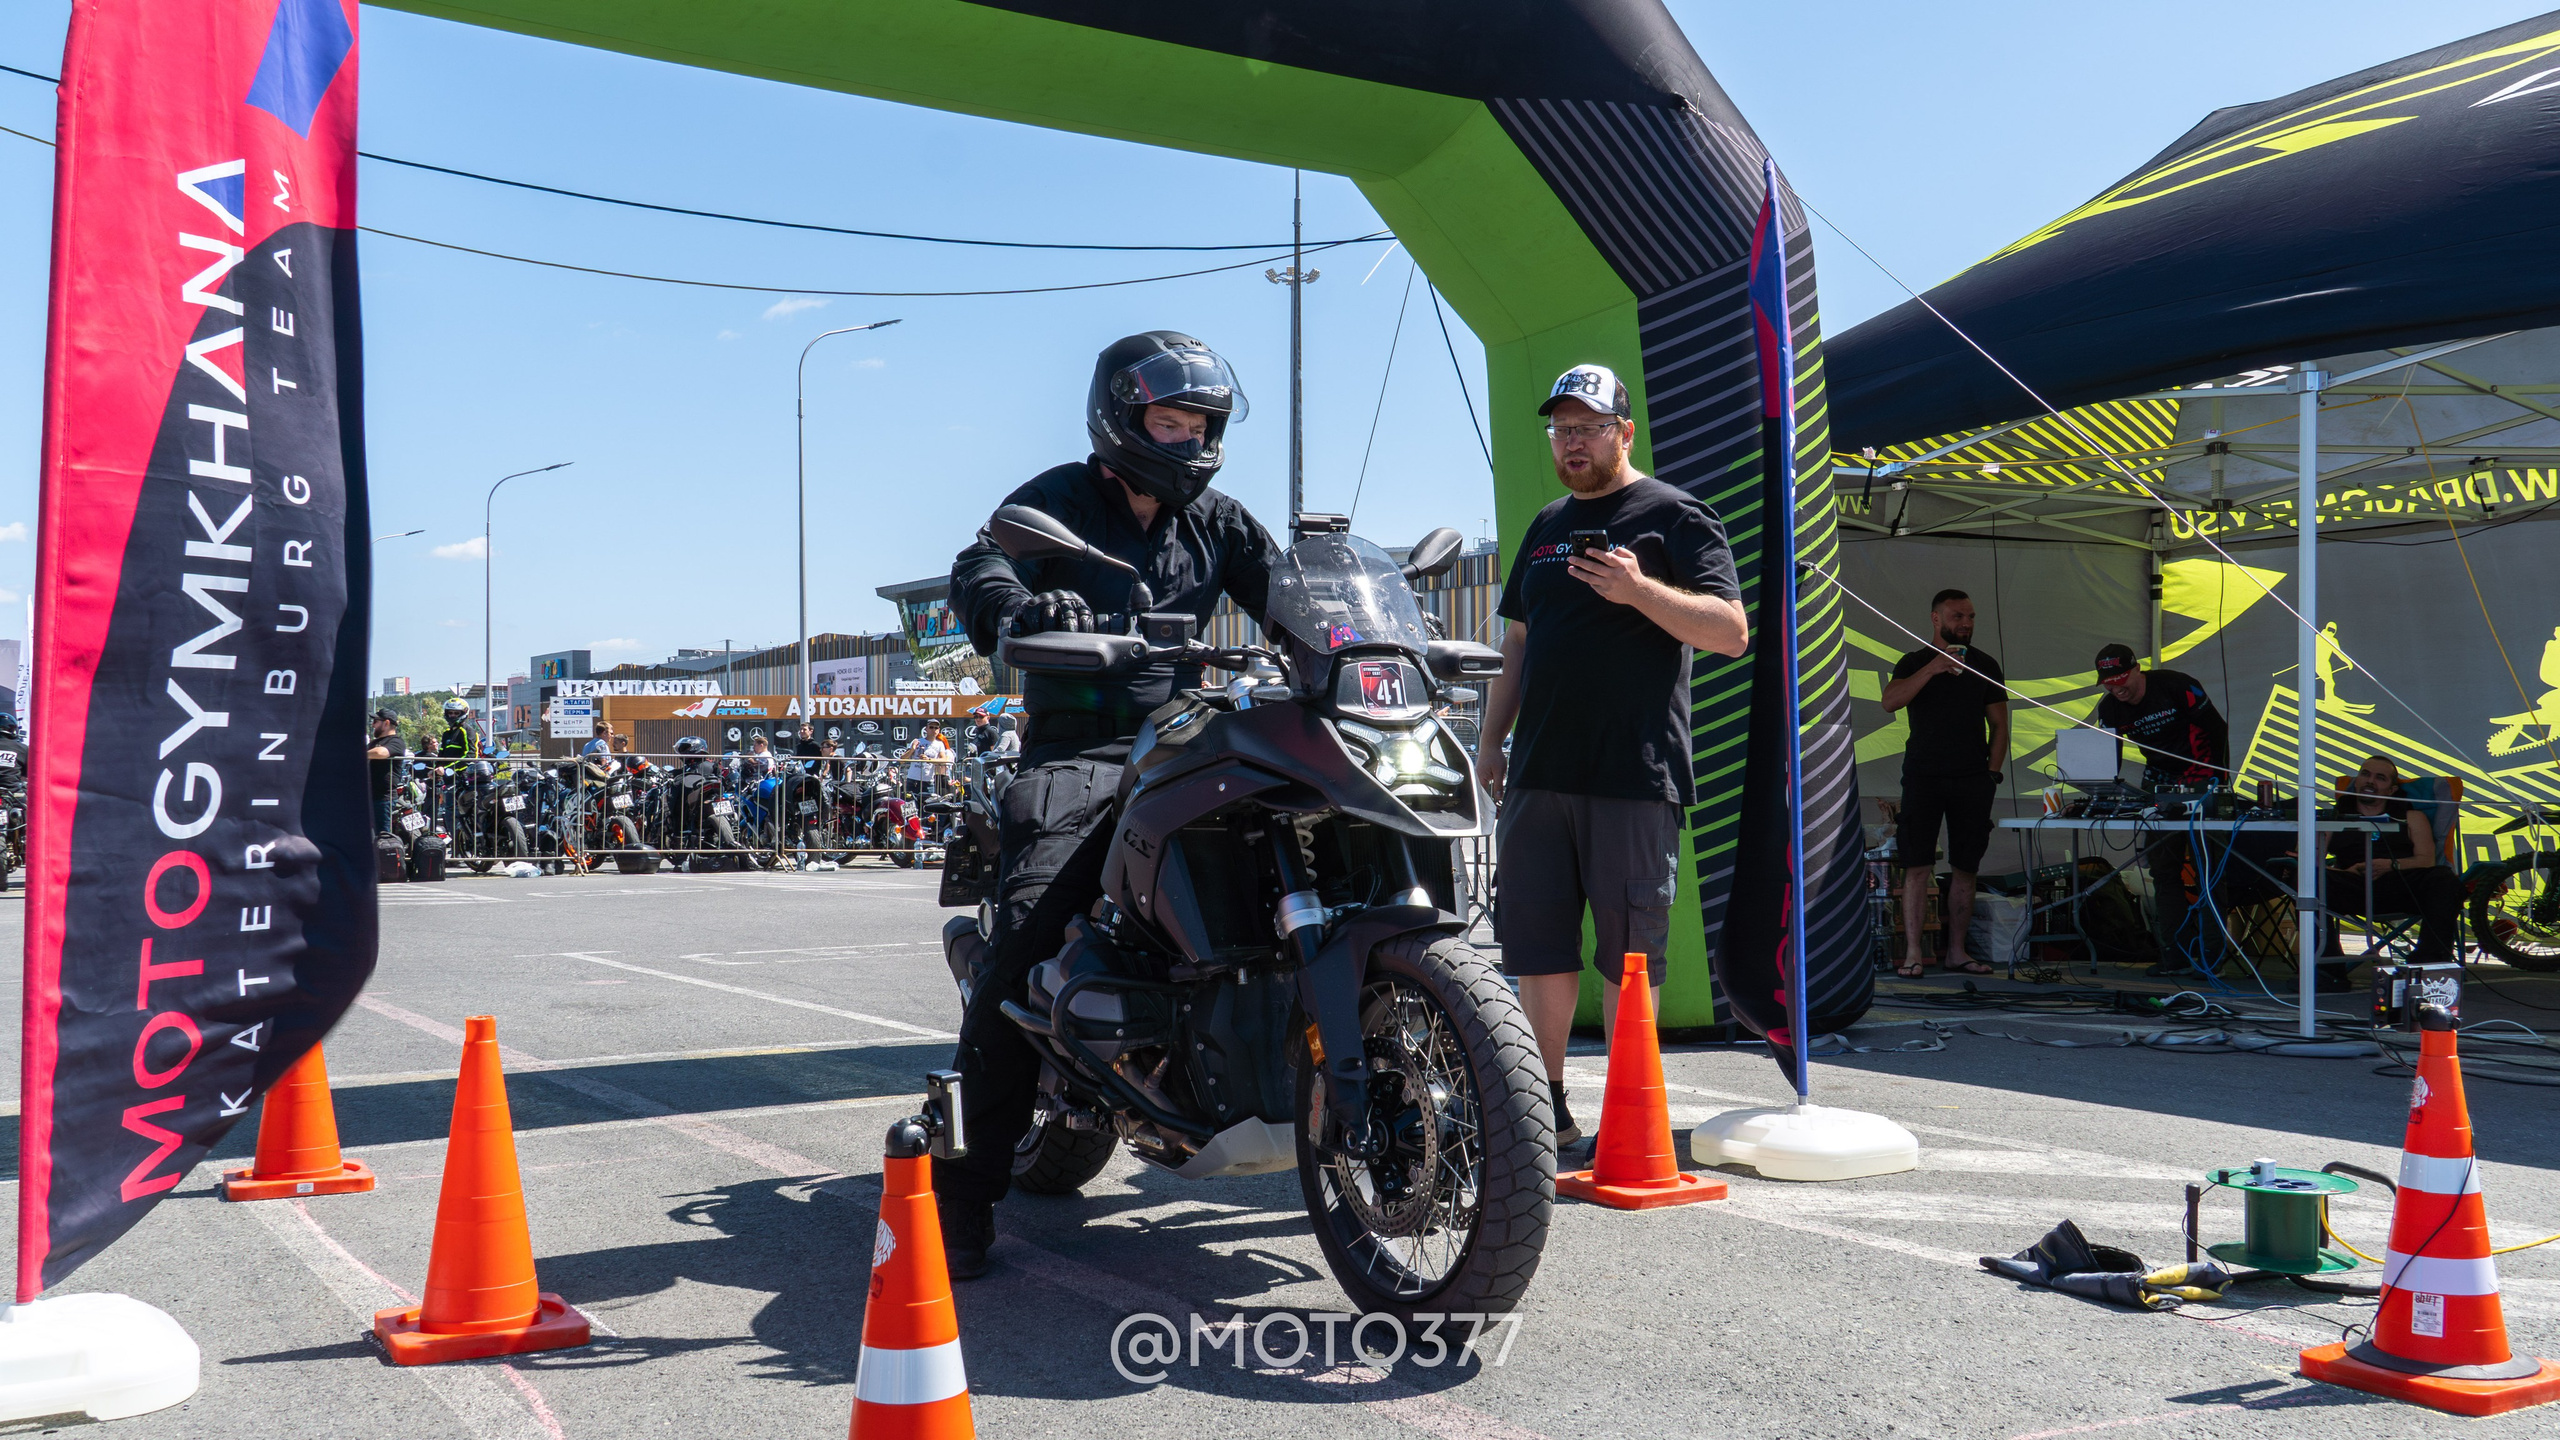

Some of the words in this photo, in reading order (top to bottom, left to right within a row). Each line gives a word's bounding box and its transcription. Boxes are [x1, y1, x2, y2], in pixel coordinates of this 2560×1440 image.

[272, 169, 298, 395] TEAM
[1096, 408, 1123, 447] LS2
[120, 158, 253, 1203] MOTOGYMKHANA
[1376, 678, 1404, 705] 41
[715, 707, 768, 716] ЯПОНЕЦ
[717, 699, 751, 707] АВТО
[786, 697, 953, 716] АВТОЗАПЧАСТИ
[1123, 828, 1157, 859] GS
[1312, 1091, 1321, 1128] BMW
